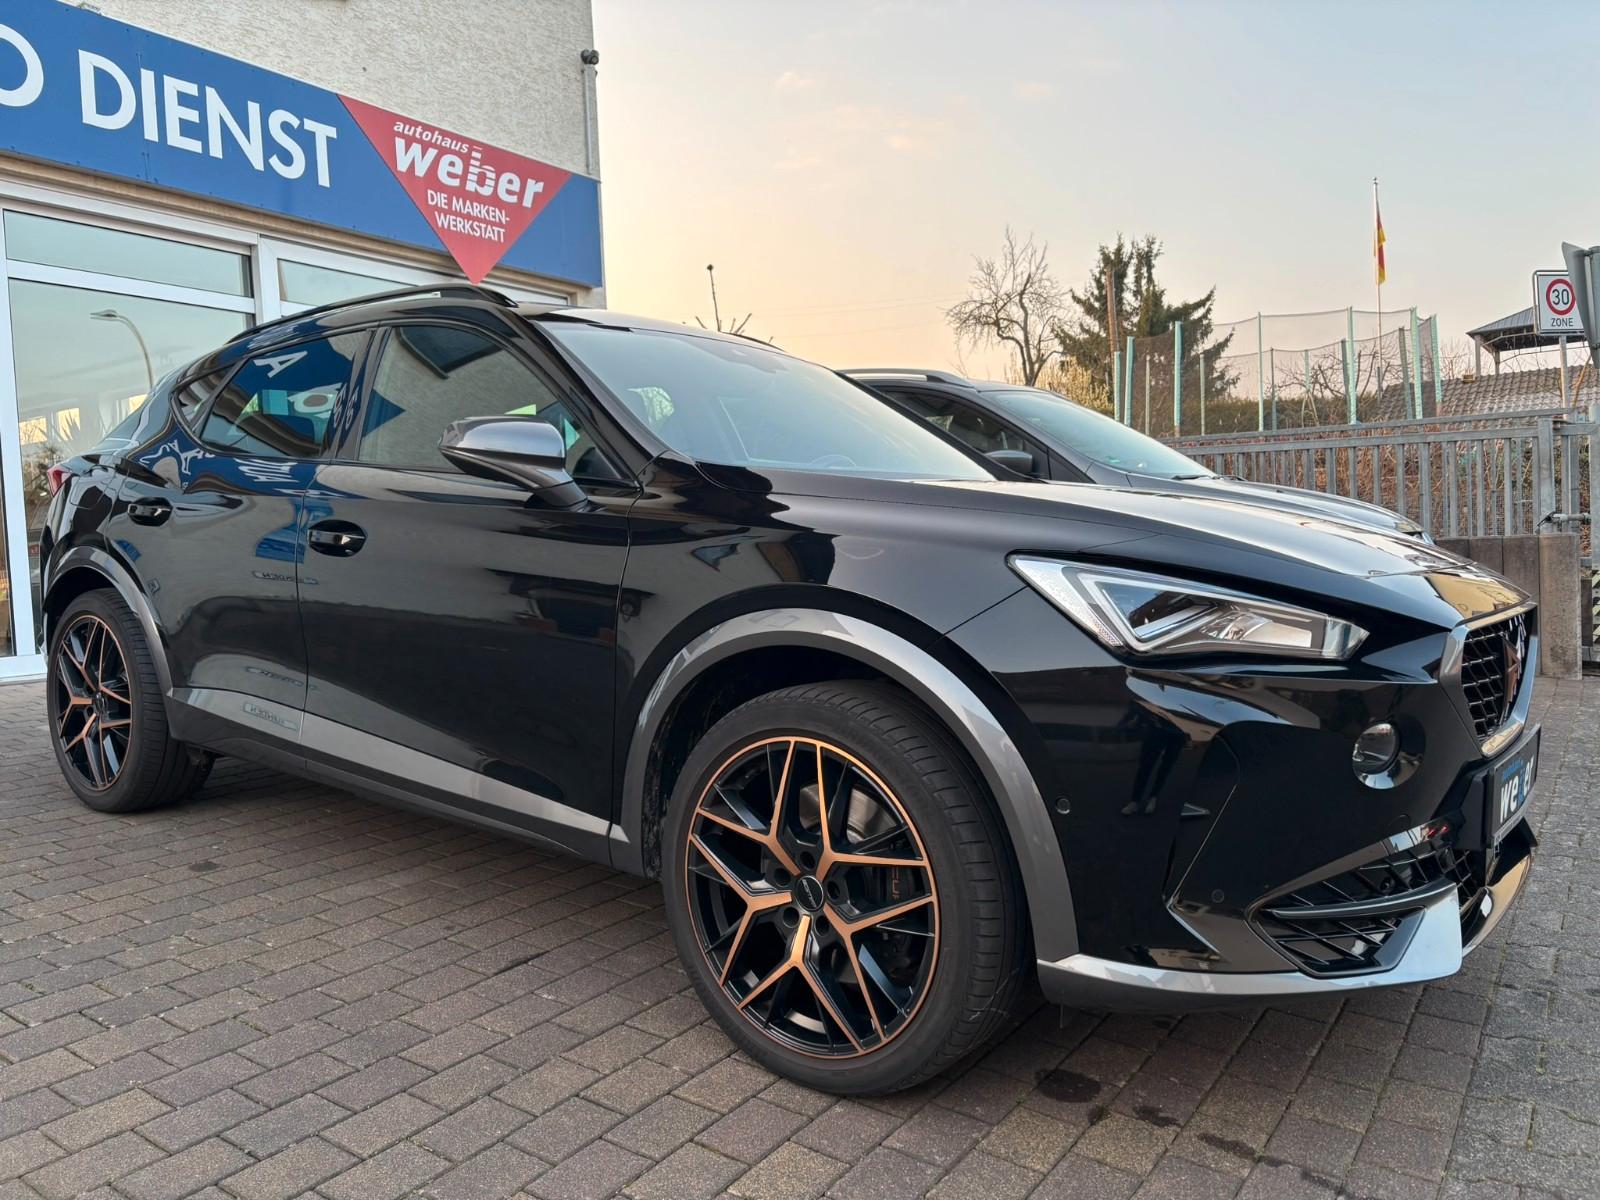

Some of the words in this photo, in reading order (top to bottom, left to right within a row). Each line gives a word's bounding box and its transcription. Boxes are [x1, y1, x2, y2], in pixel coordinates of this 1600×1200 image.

[78, 48, 337, 188] DIENST
[393, 121, 469, 153] autohaus
[394, 136, 544, 208] weber
[427, 189, 448, 209] DIE
[452, 198, 510, 224] MARKEN-
[435, 211, 505, 243] WERKSTATT
[1552, 288, 1570, 305] 30
[1551, 317, 1574, 327] ZONE
